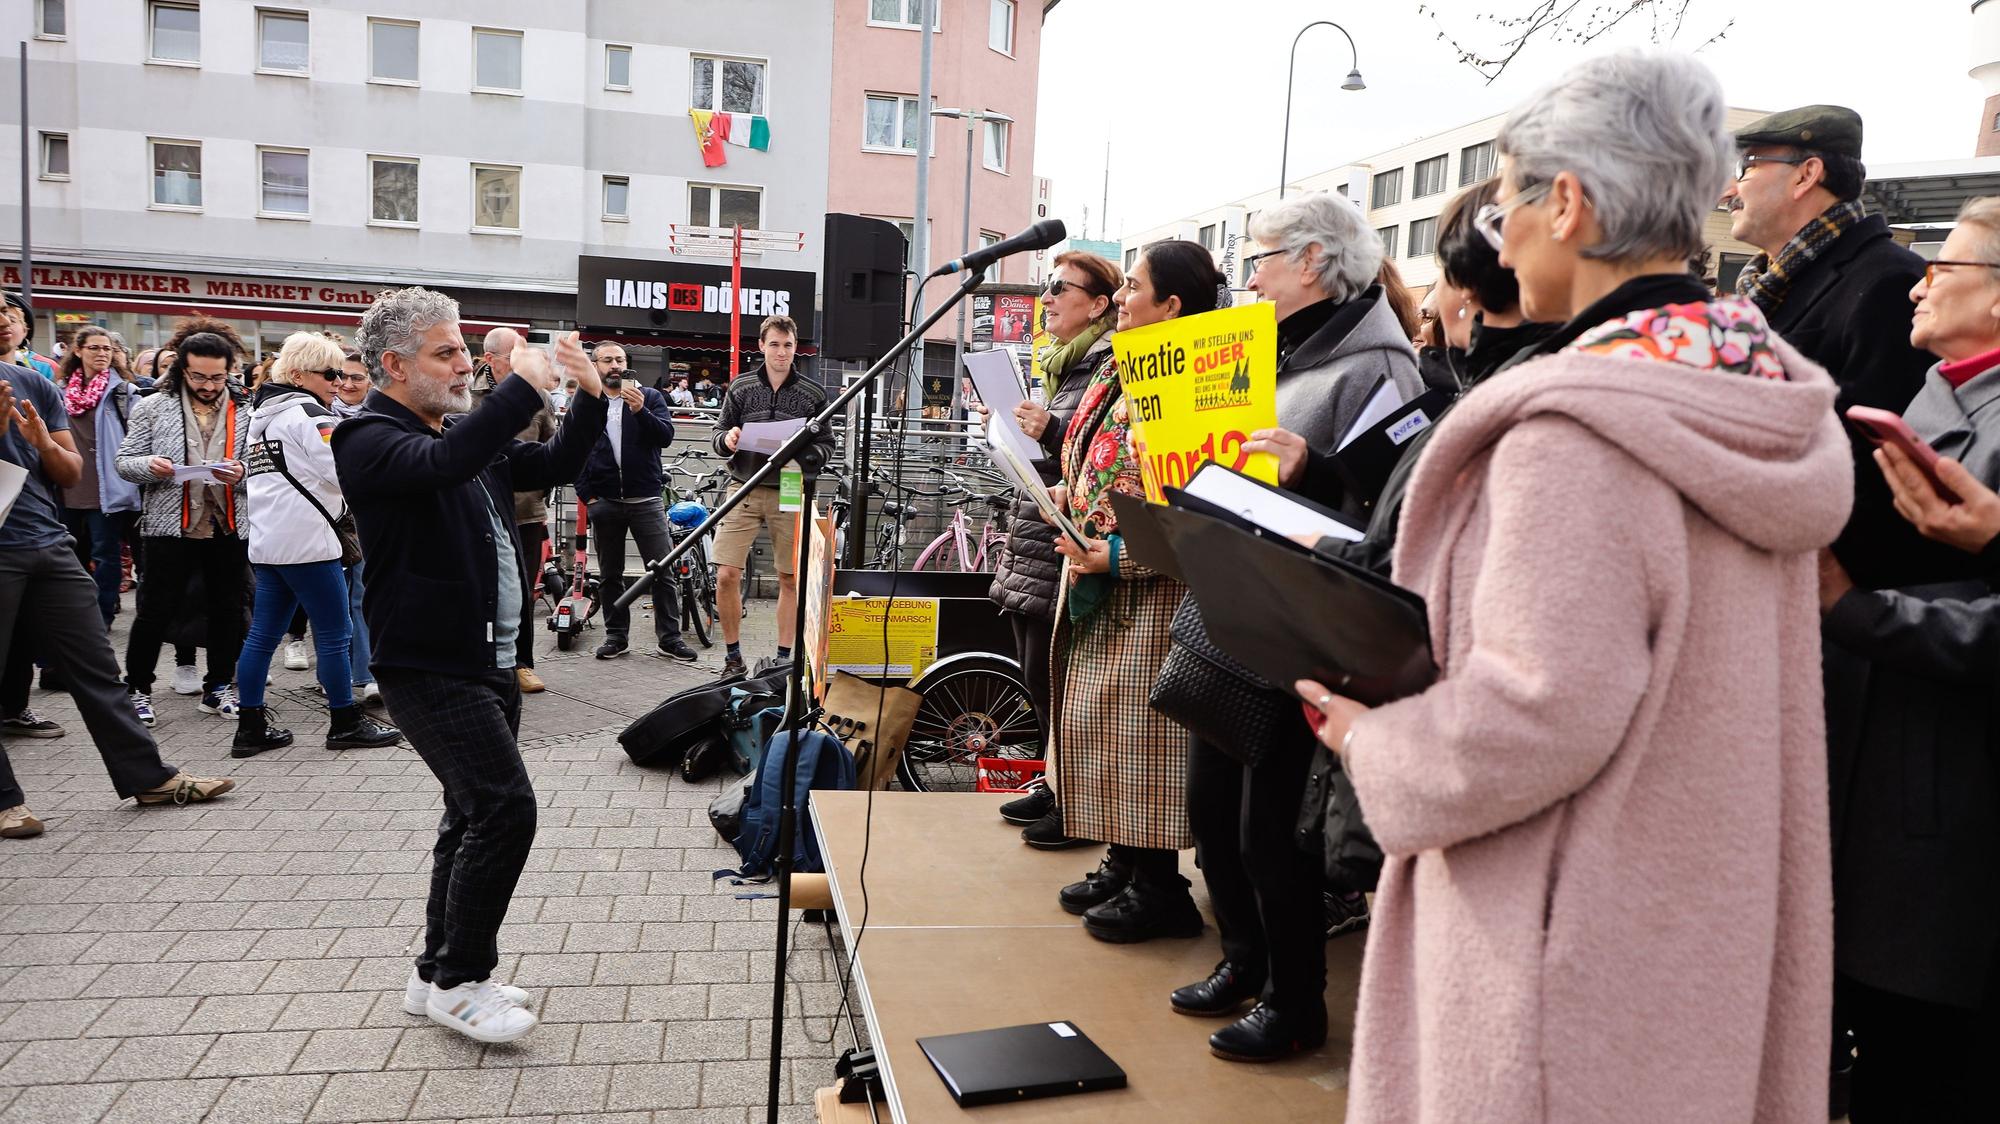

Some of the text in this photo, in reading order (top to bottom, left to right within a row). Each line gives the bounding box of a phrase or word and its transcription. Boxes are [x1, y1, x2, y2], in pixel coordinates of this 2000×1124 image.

[1036, 178, 1048, 285] Hoel
[3, 266, 376, 304] ATLANTIKER MARKET Gmb
[605, 278, 790, 317] HAUS DES DÖNERS
[1001, 297, 1030, 309] Dance
[1193, 329, 1254, 350] WIR STELLEN UNS
[1118, 341, 1185, 385] okratie
[1193, 342, 1245, 374] QUER
[864, 614, 932, 623] STERNMARSCH
[865, 600, 932, 609] KUNDGEBUNG
